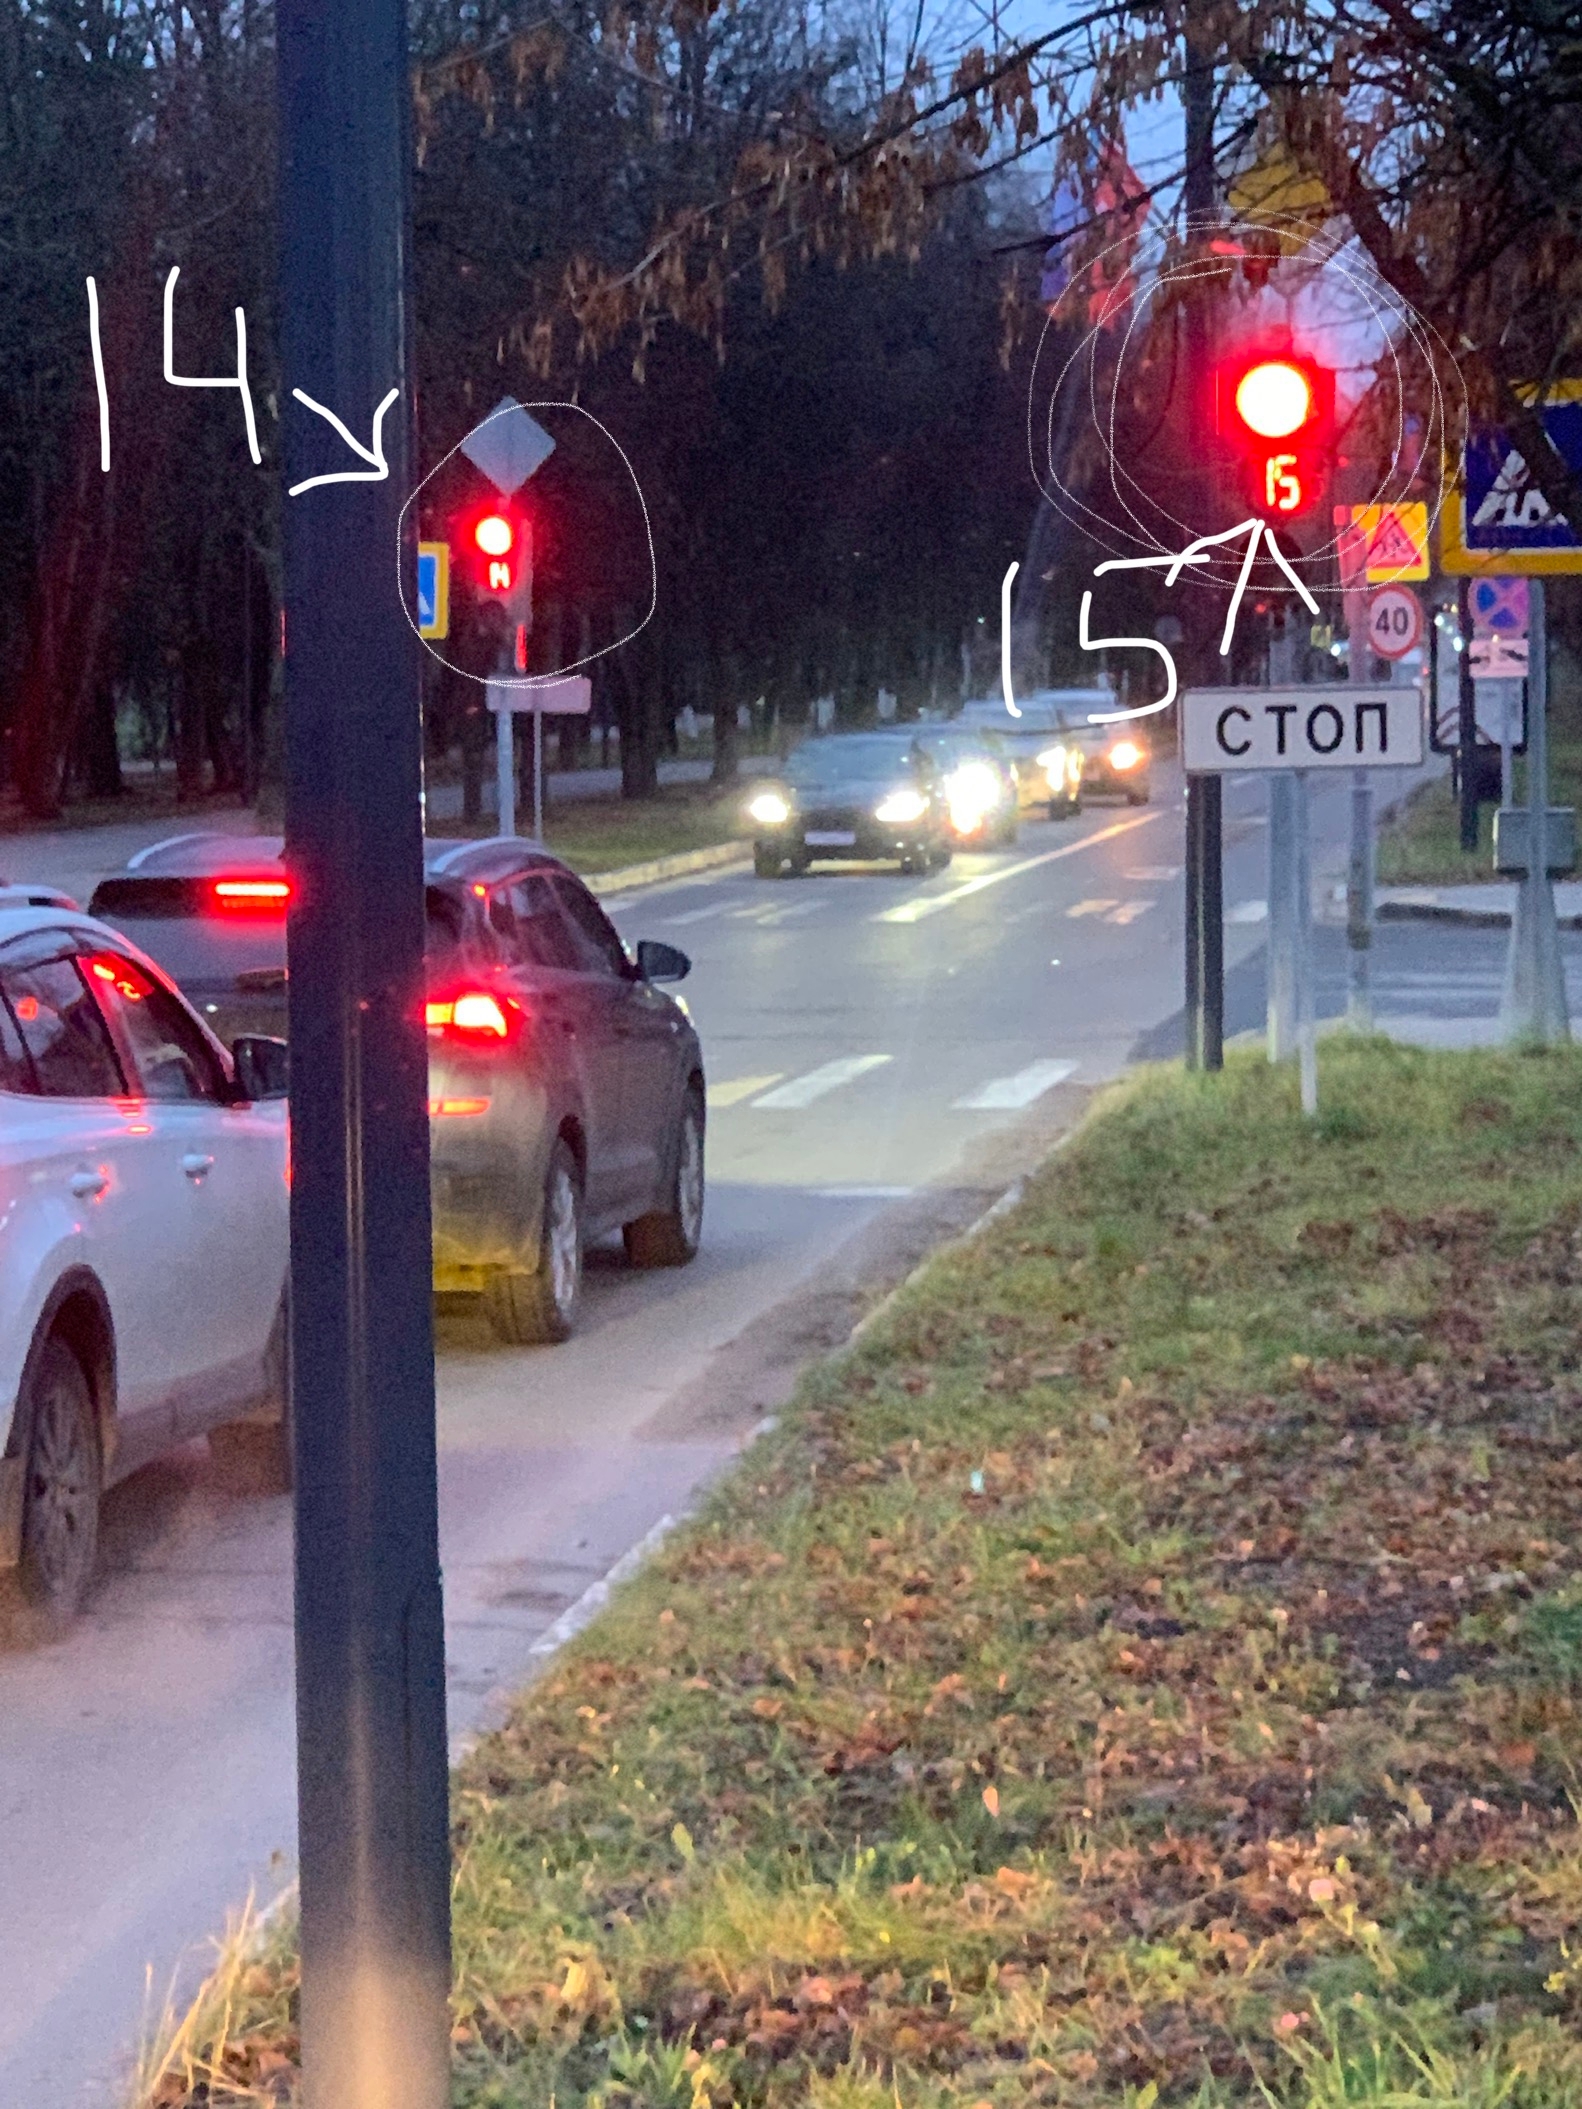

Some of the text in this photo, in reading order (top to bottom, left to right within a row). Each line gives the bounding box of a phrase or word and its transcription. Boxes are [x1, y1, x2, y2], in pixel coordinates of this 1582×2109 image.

[1265, 454, 1301, 510] 15
[1375, 606, 1409, 636] 40
[1216, 702, 1389, 756] СТОП
